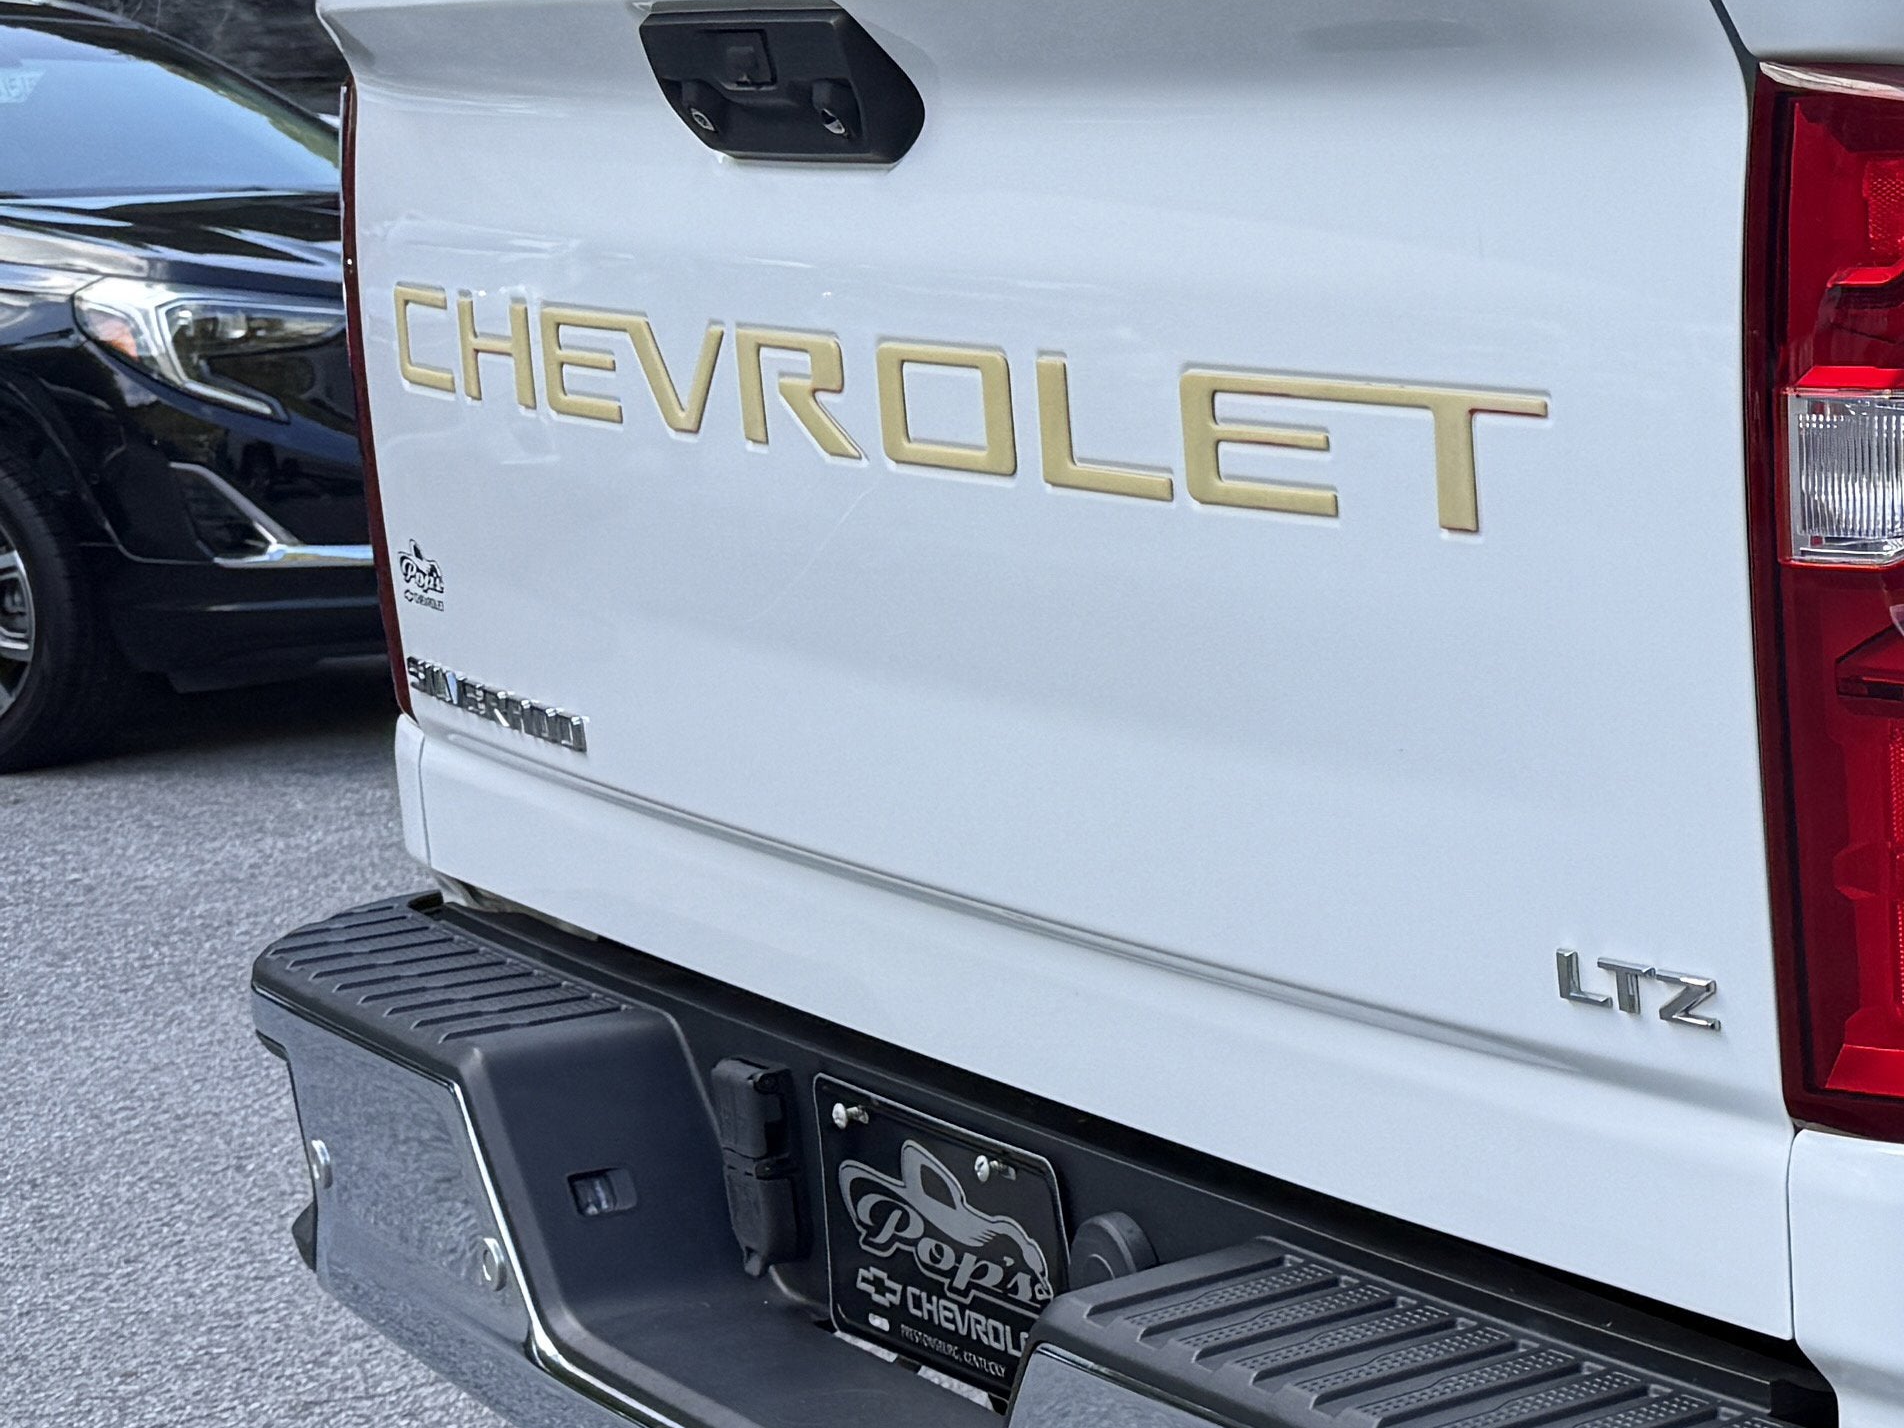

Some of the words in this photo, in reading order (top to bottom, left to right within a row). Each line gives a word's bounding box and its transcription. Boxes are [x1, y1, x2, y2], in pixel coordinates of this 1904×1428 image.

[393, 283, 1549, 533] CHEVROLET
[406, 655, 589, 754] SILVERADO
[1555, 947, 1722, 1032] LTZ
[856, 1192, 1033, 1304] Pop's
[906, 1285, 1030, 1358] CHEVROL
